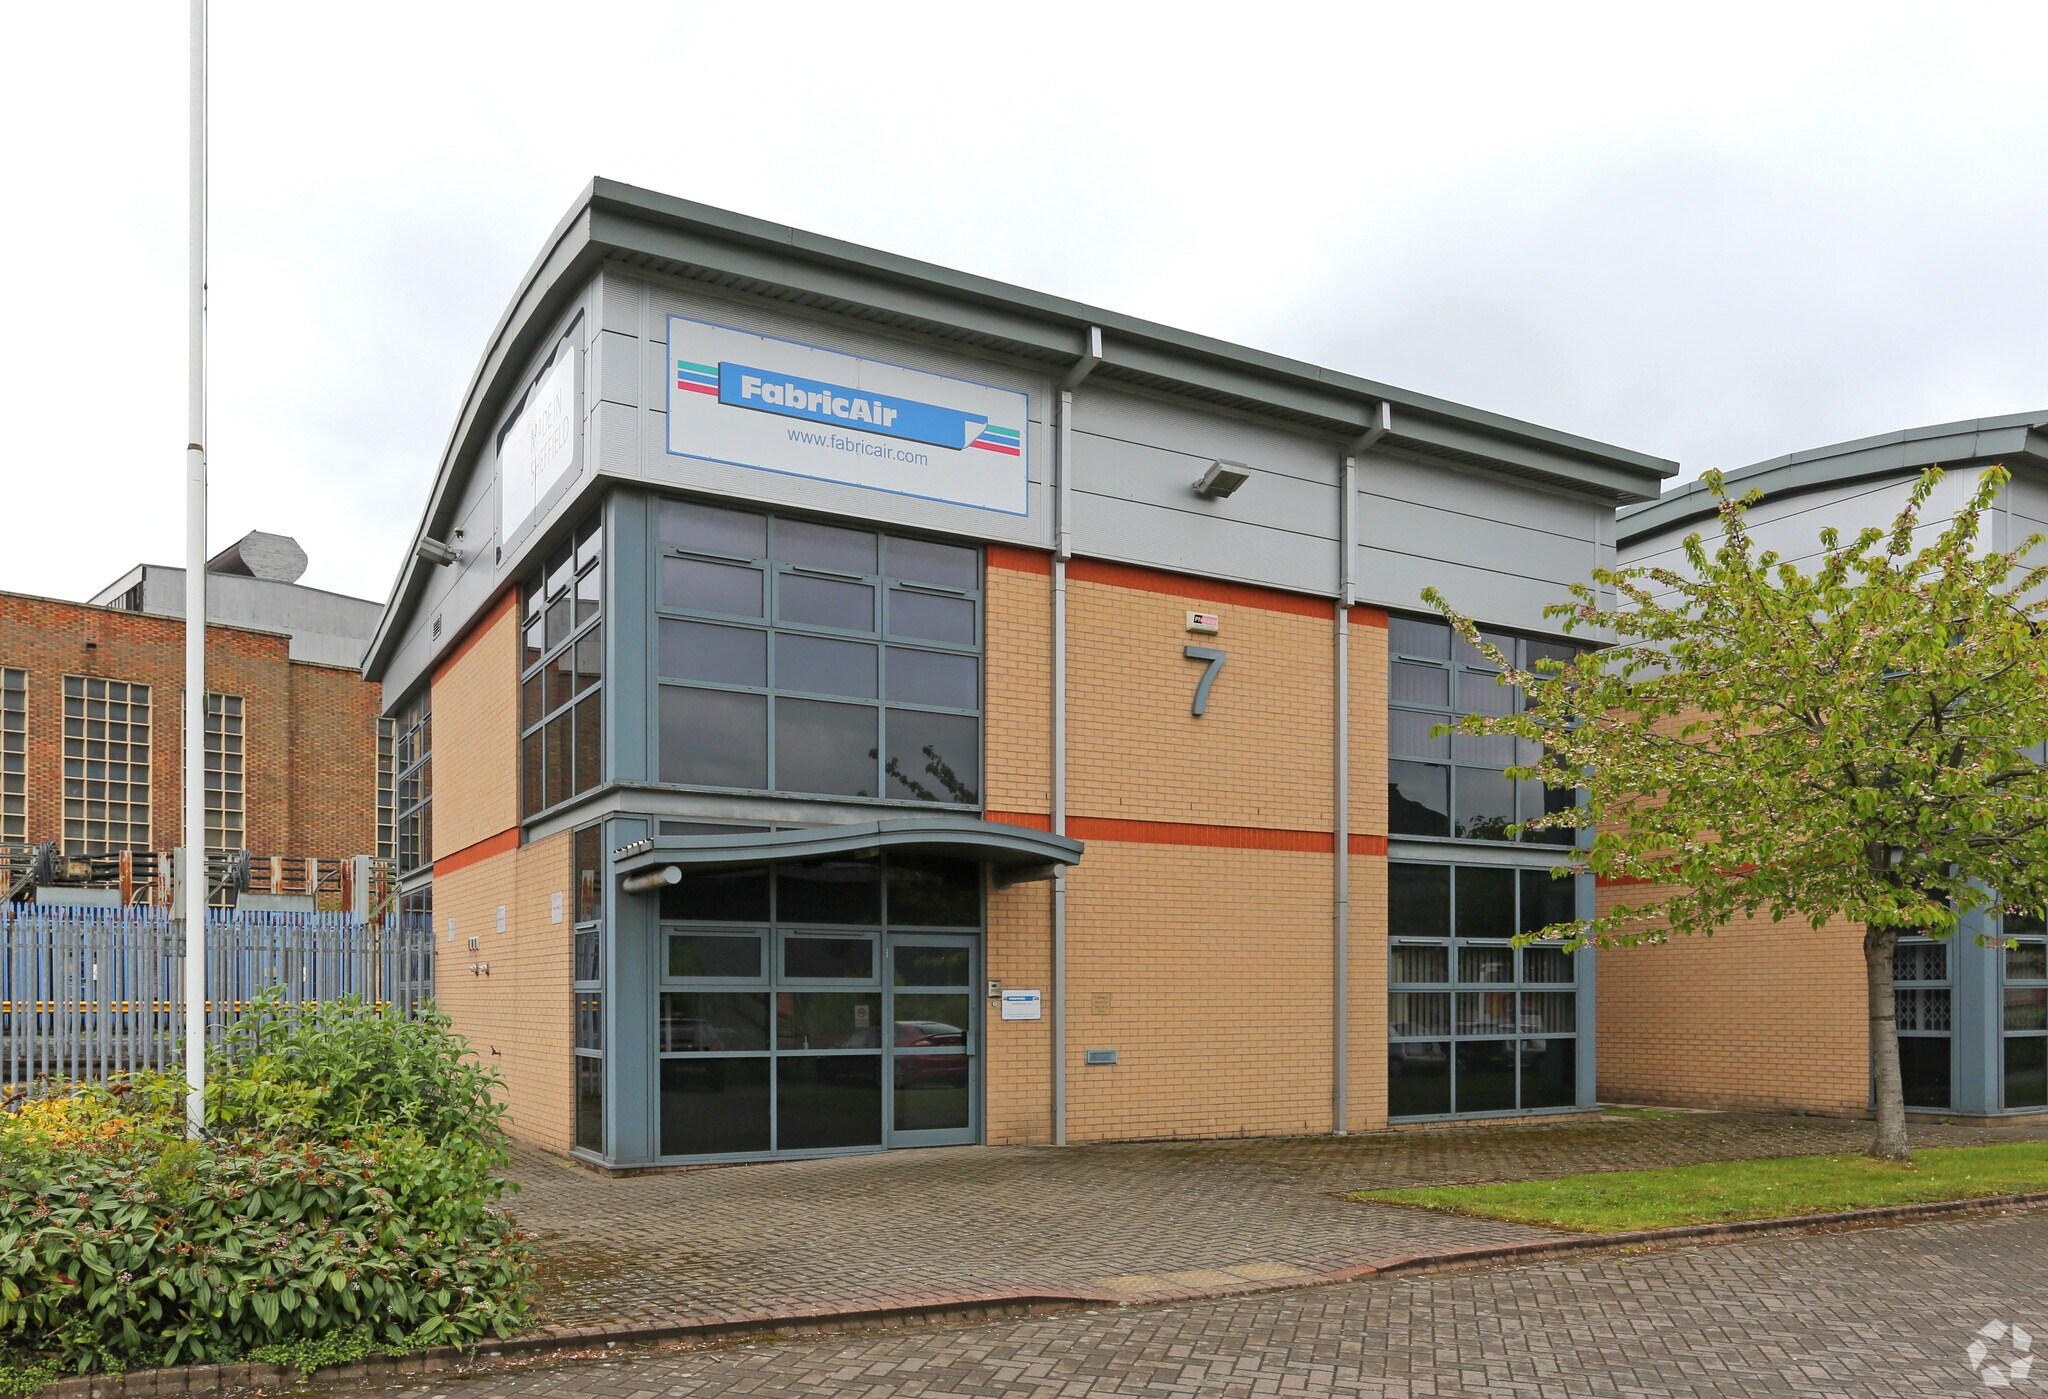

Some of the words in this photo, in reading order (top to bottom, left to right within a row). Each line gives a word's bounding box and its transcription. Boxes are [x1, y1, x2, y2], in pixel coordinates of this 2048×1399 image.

[530, 402, 552, 453] MADE
[553, 387, 562, 422] IN
[741, 374, 898, 427] FabricAir
[530, 415, 570, 486] SHEFFIELD
[787, 428, 929, 466] www.fabricair.com
[1183, 645, 1226, 717] 7
